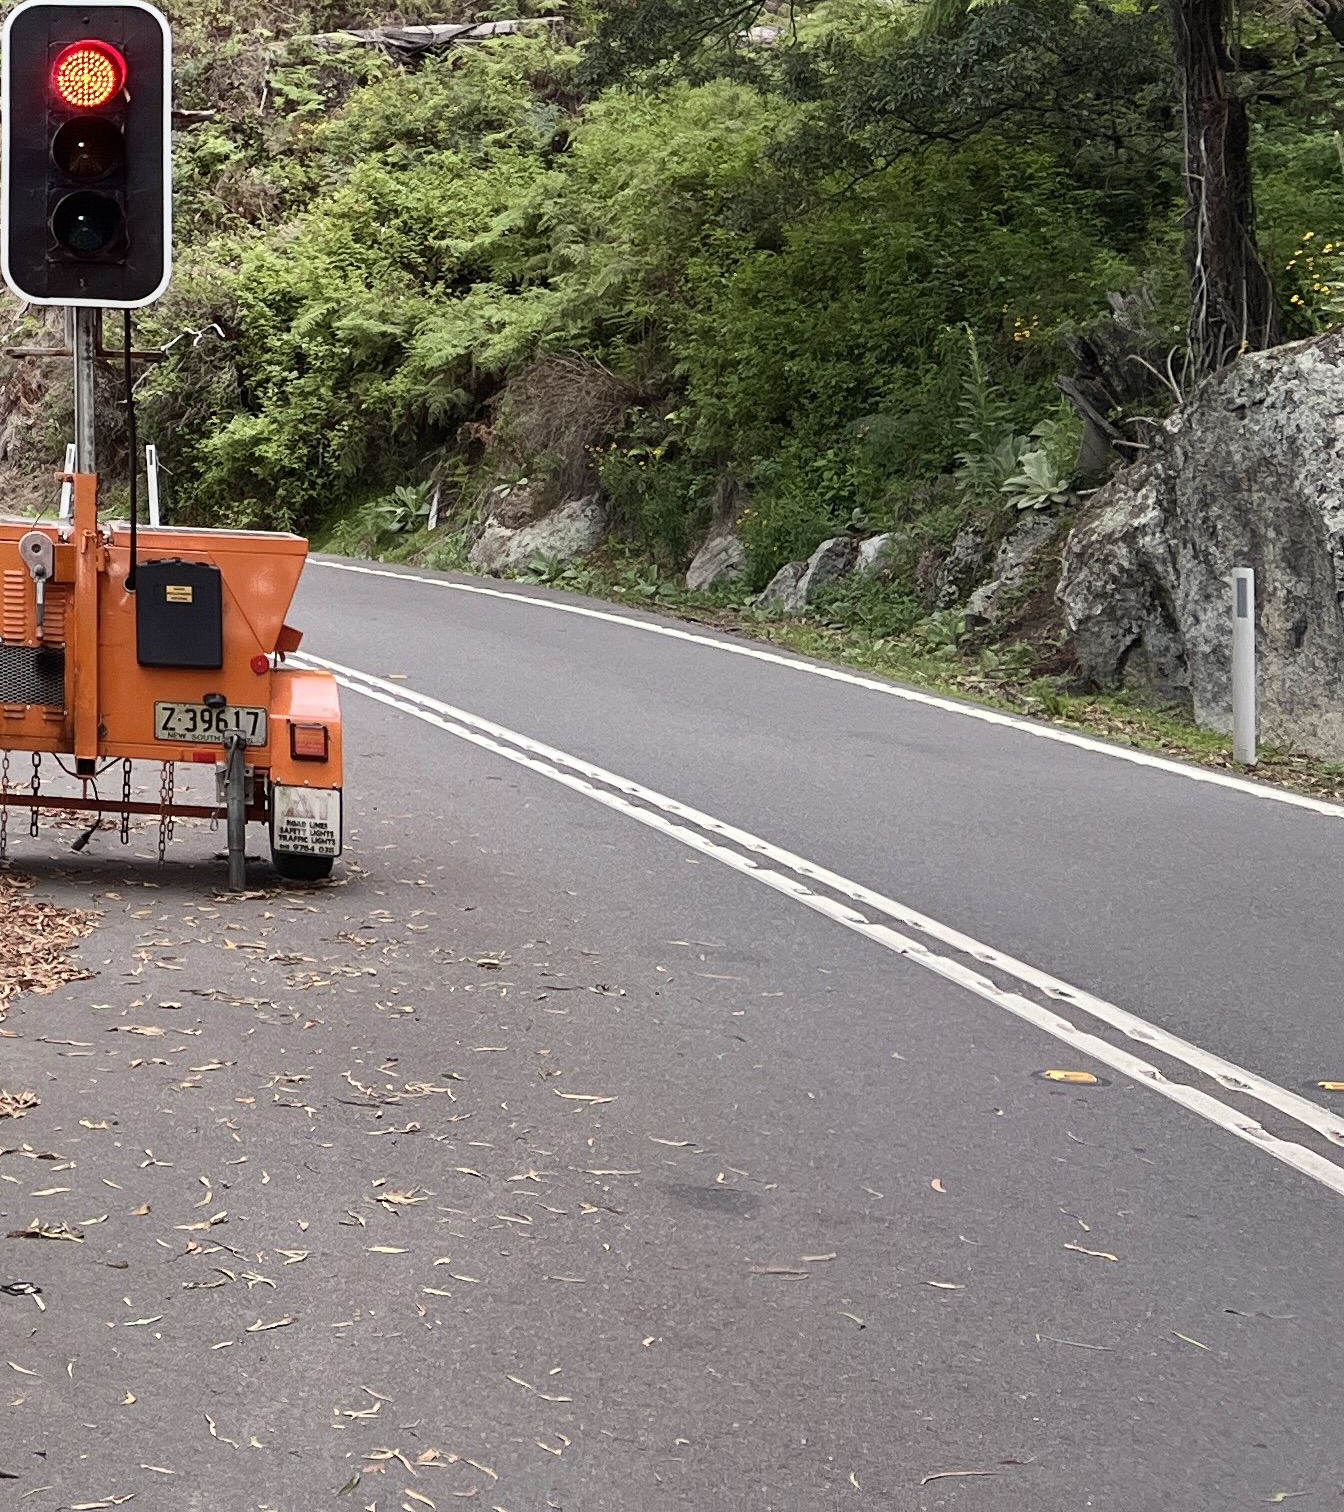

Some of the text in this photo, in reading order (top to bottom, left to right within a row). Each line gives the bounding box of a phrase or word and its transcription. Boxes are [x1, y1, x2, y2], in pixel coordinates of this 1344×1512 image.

[192, 733, 221, 741] SOUTH
[278, 834, 335, 846] TRAFFIC LIGHTS
